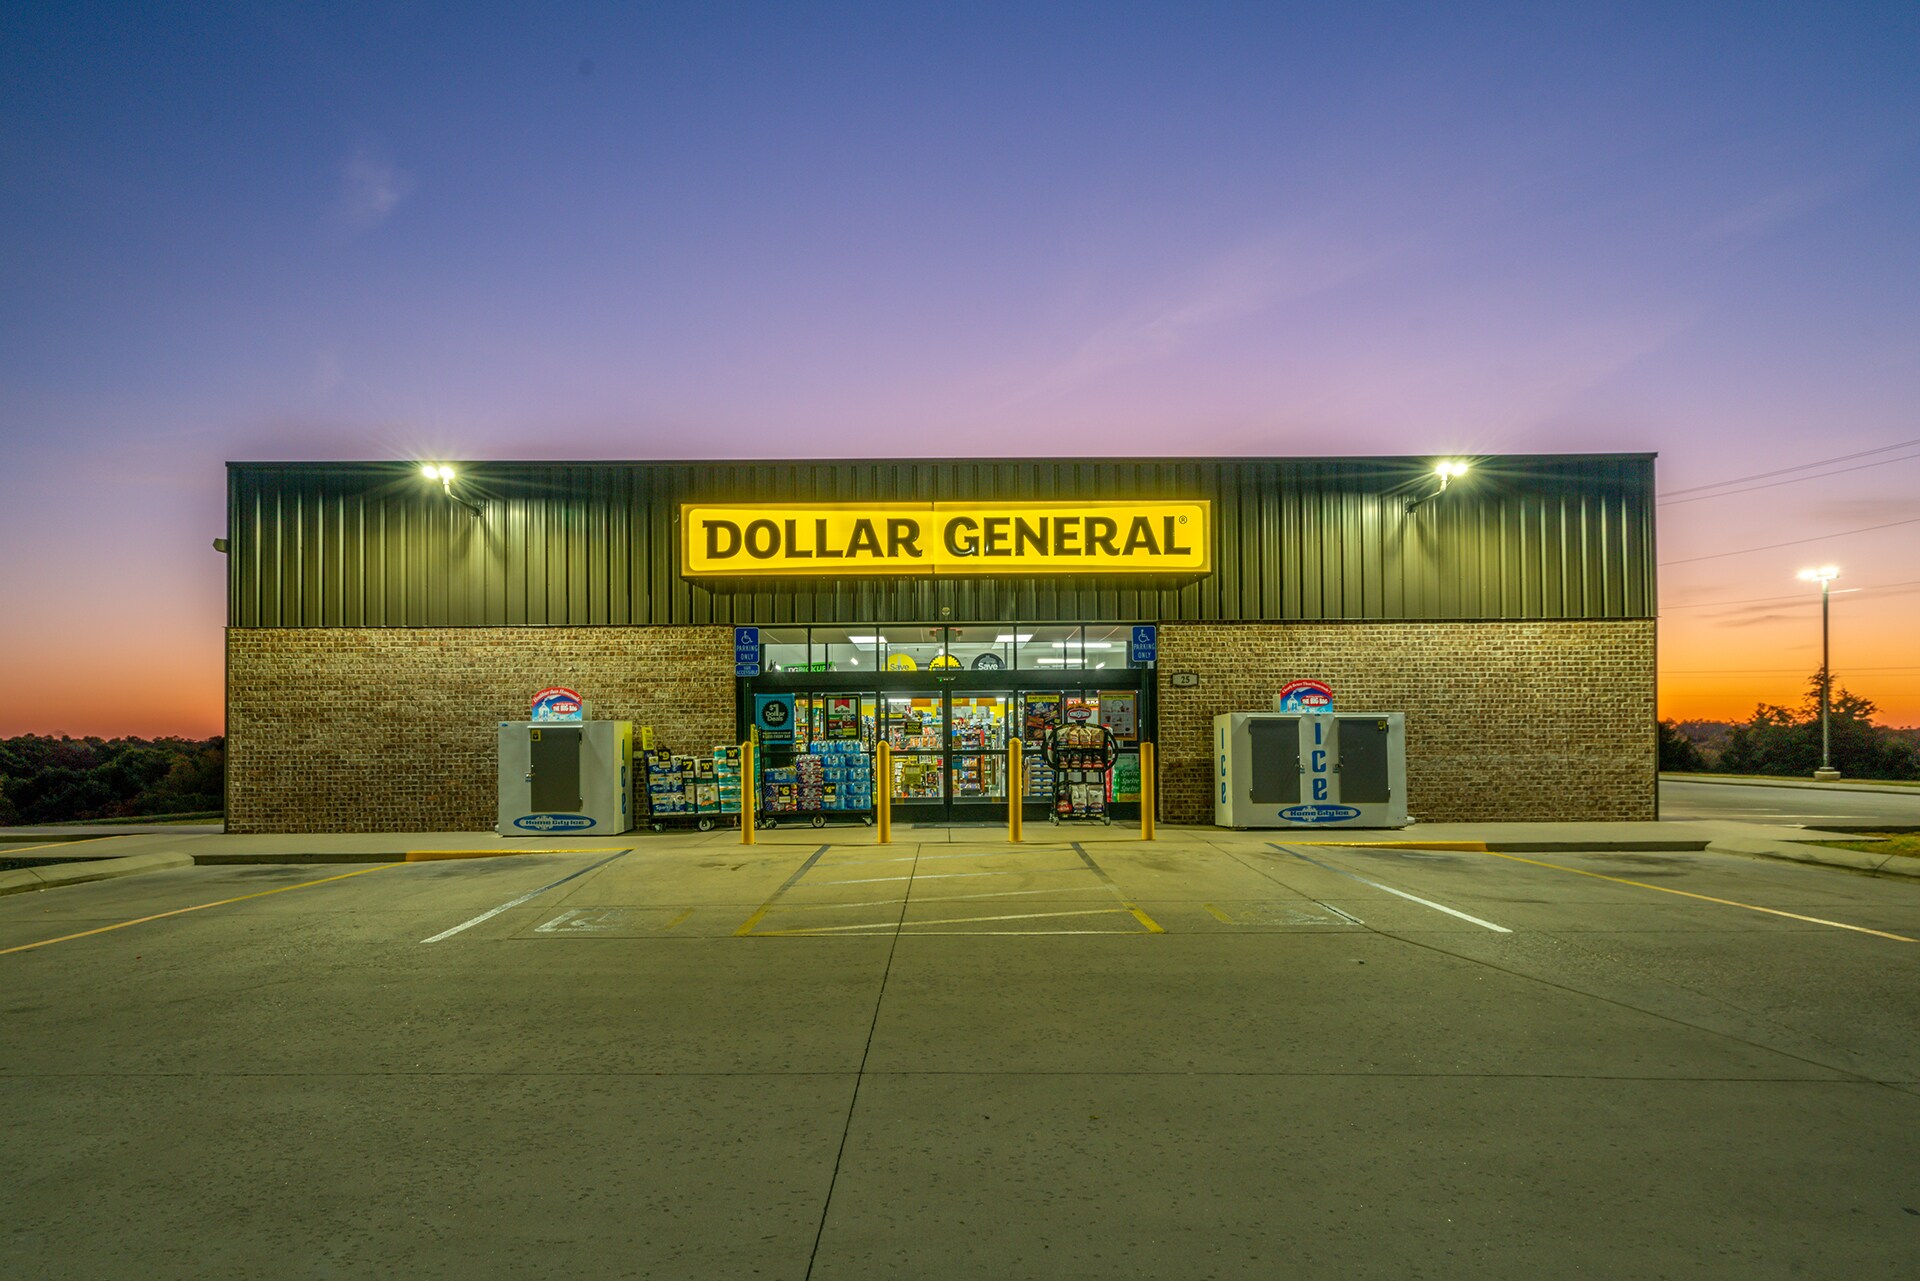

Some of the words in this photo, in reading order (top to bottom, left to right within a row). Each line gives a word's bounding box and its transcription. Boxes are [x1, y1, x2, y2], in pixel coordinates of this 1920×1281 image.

[702, 518, 923, 559] DOLLAR
[943, 515, 1192, 557] GENERAL
[890, 663, 909, 671] Save
[978, 663, 998, 671] Save
[1181, 675, 1190, 684] 25
[658, 751, 670, 761] $9
[682, 761, 693, 770] $7
[779, 786, 790, 796] $6
